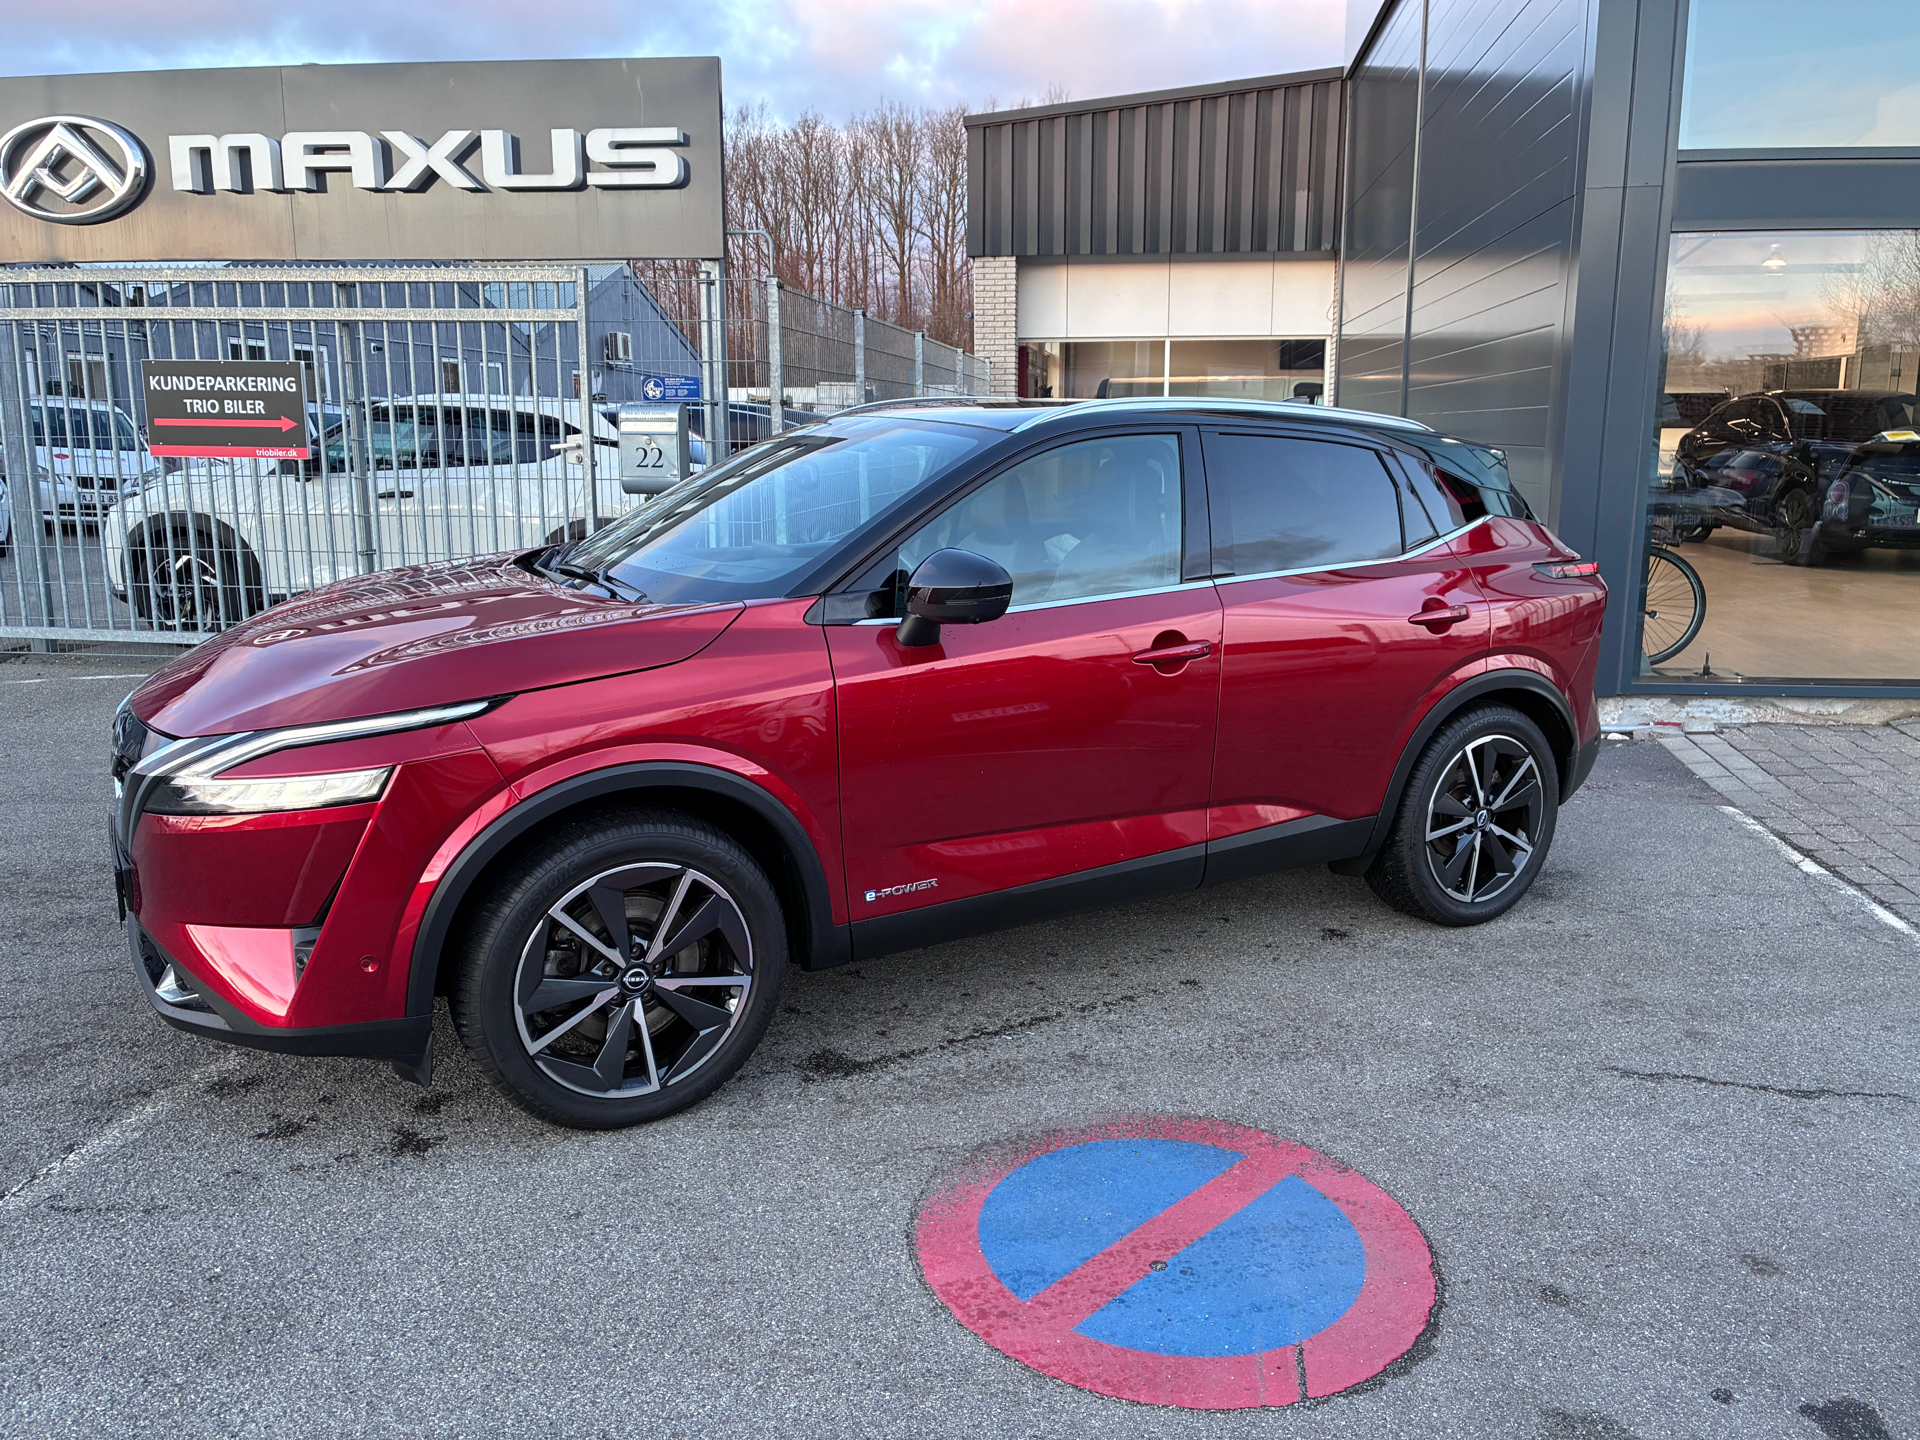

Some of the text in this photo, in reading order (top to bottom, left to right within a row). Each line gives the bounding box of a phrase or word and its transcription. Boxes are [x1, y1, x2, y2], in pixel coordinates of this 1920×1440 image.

[168, 127, 686, 191] MAXUS
[149, 375, 297, 392] KUNDEPARKERING
[183, 399, 266, 414] TRIO BILER
[256, 449, 298, 457] triobiler.dk
[635, 447, 664, 468] 22
[864, 878, 938, 902] e-POWER
[622, 975, 650, 983] NISSAN
